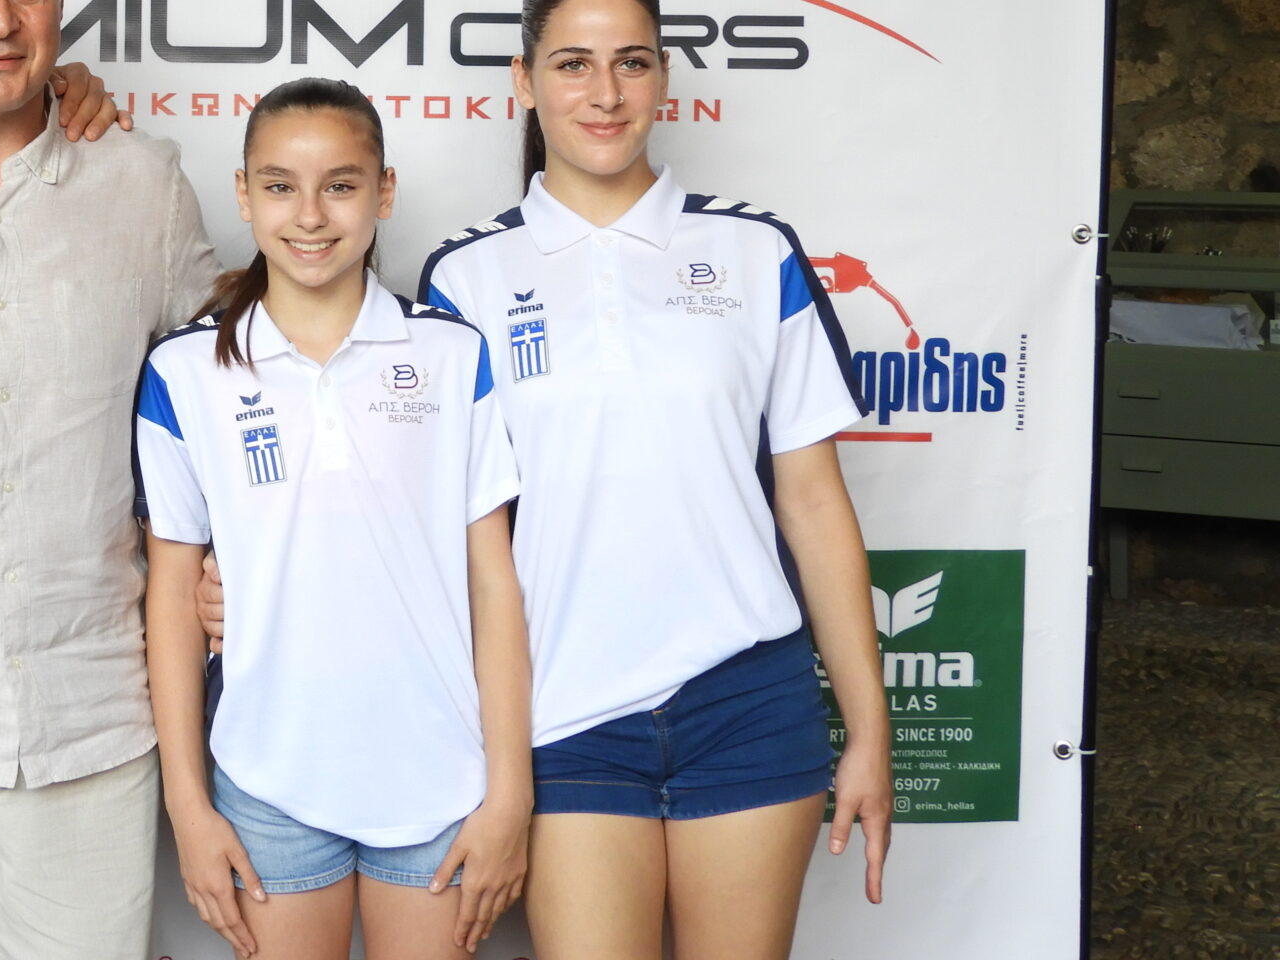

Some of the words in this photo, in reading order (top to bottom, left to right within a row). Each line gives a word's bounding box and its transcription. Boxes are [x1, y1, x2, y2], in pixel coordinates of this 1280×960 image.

[450, 12, 810, 69] CRS
[507, 303, 544, 317] erima
[235, 405, 275, 422] erima
[403, 401, 441, 415] ΒΕΡΟΗ
[890, 694, 938, 712] LAS
[896, 728, 936, 742] SINCE
[939, 727, 974, 742] 1900
[915, 801, 976, 812] erima_hellas
